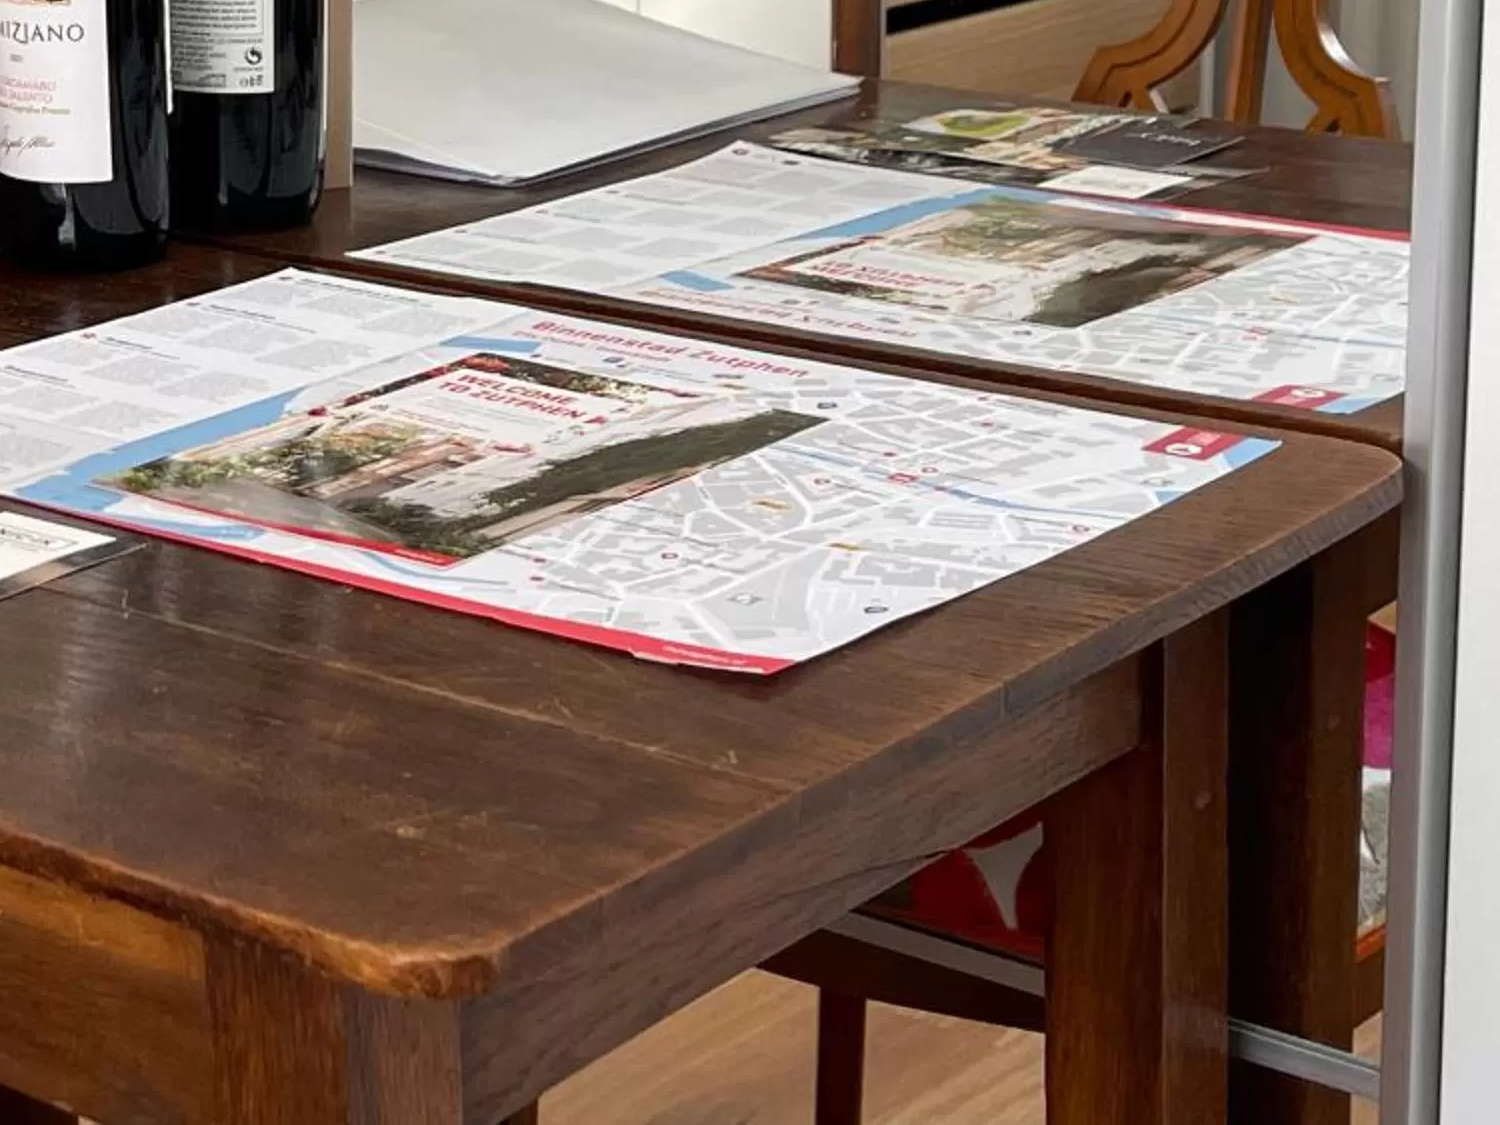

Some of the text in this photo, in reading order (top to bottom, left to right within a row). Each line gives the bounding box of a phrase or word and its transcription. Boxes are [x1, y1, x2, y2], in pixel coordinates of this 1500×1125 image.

[531, 320, 689, 357] Binnenstad
[690, 349, 809, 378] Zutphen
[438, 381, 470, 395] TO
[471, 388, 587, 420] ZUTPHEN
[458, 374, 579, 405] WELCOME
